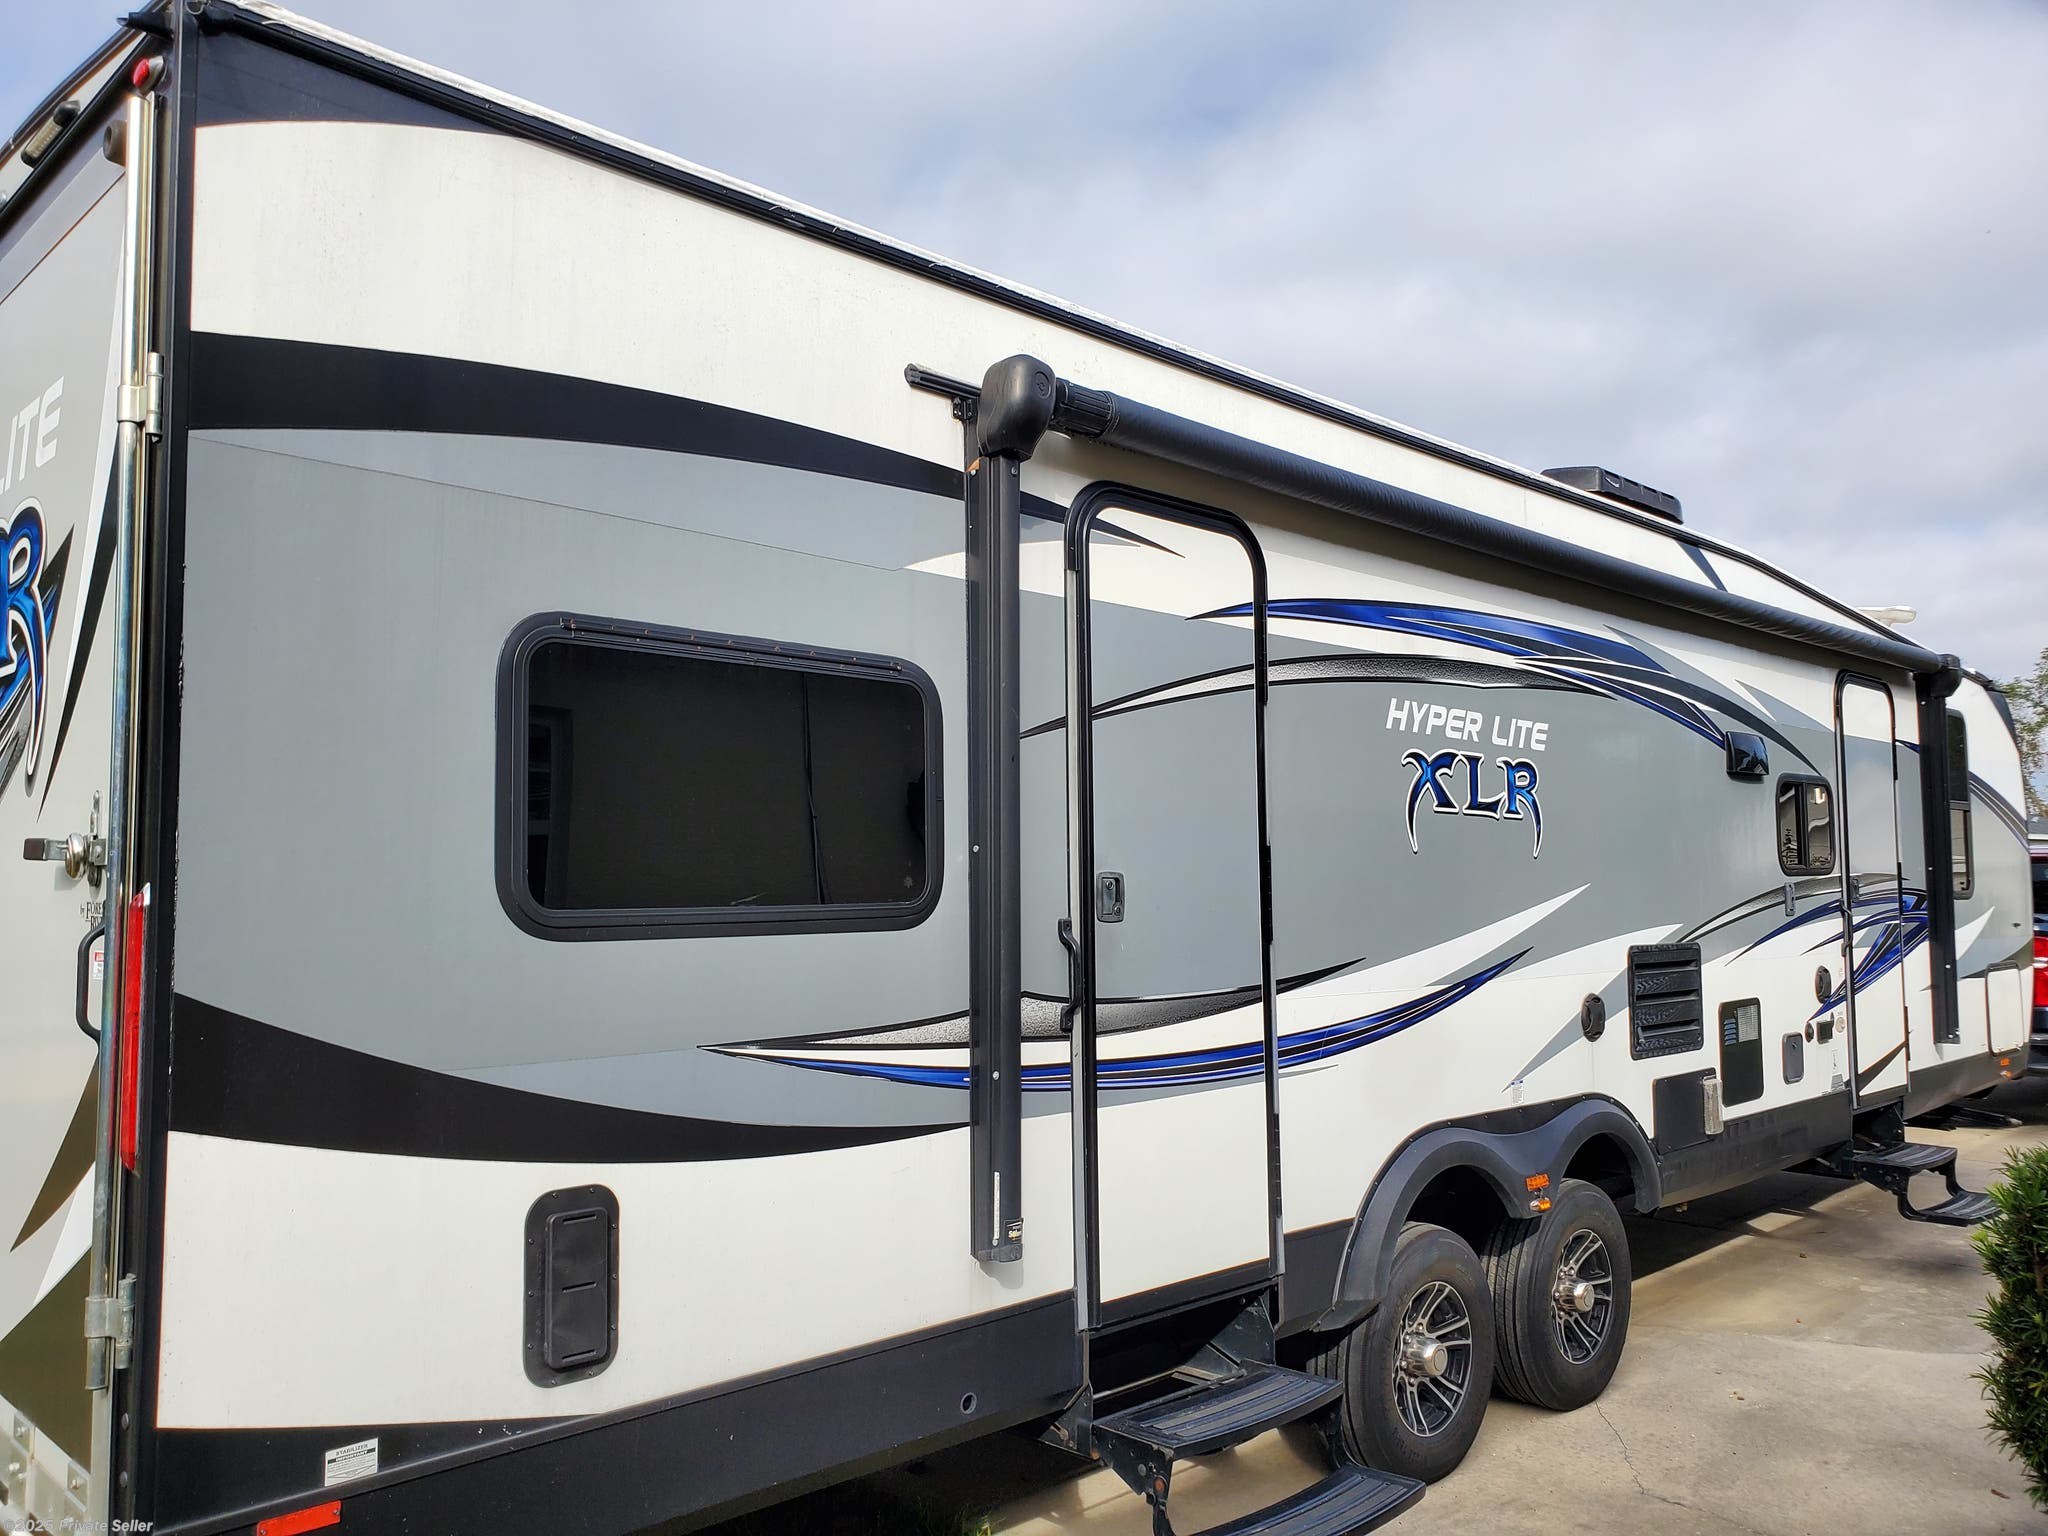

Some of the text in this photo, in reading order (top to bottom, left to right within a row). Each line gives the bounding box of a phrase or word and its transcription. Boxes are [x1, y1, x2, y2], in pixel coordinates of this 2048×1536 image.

[0, 376, 64, 494] ITE
[1386, 697, 1549, 751] HYPER LITE
[1401, 748, 1543, 859] XLR
